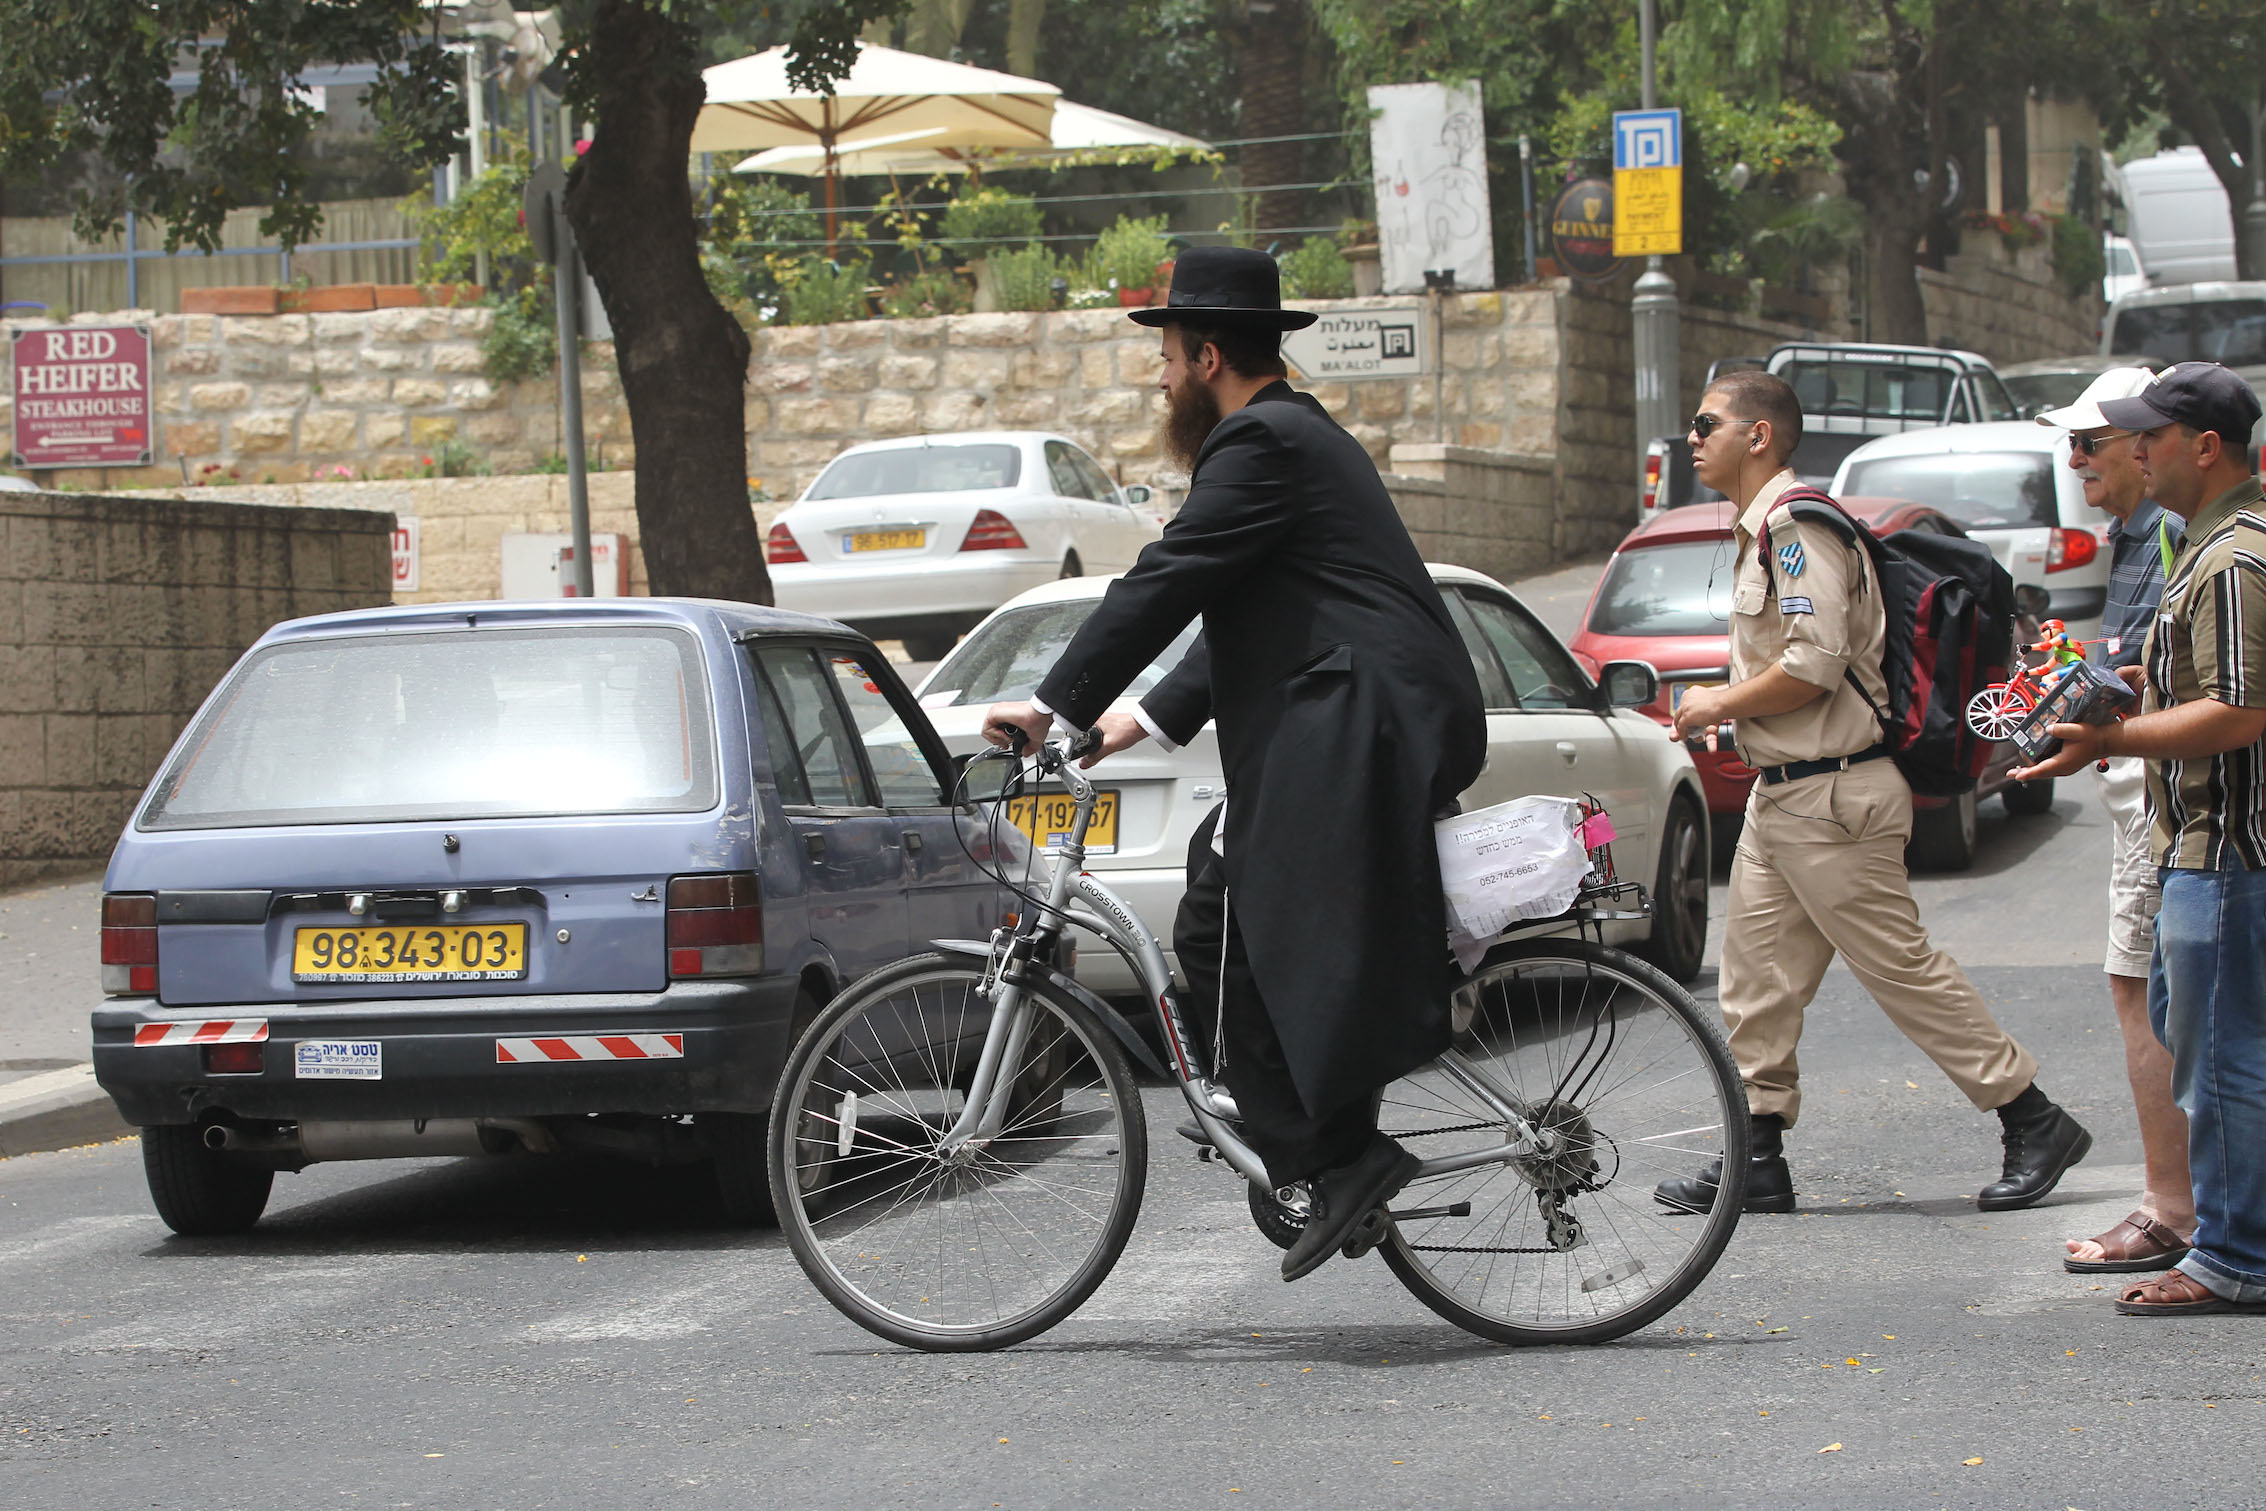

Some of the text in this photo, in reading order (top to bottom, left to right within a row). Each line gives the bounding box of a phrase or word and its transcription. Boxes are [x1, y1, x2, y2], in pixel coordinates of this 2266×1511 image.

[1552, 221, 1613, 239] GUINNE
[1321, 318, 1381, 333] מעלות
[45, 330, 117, 361] RED
[1321, 360, 1381, 371] MA'ALOT
[19, 362, 143, 394] HEIFER
[20, 397, 143, 419] STEAKHOUSE
[1455, 814, 1536, 845] האופניים למכירה!!
[1475, 835, 1523, 856] ממש כחדש
[1479, 863, 1539, 887] 052-745-6653
[1079, 880, 1135, 931] CROSSTOWN
[405, 971, 442, 981] ירושלים
[446, 971, 481, 980] סובארו
[1164, 996, 1201, 1076] FUJI
[323, 1044, 378, 1056] טסט אריה
